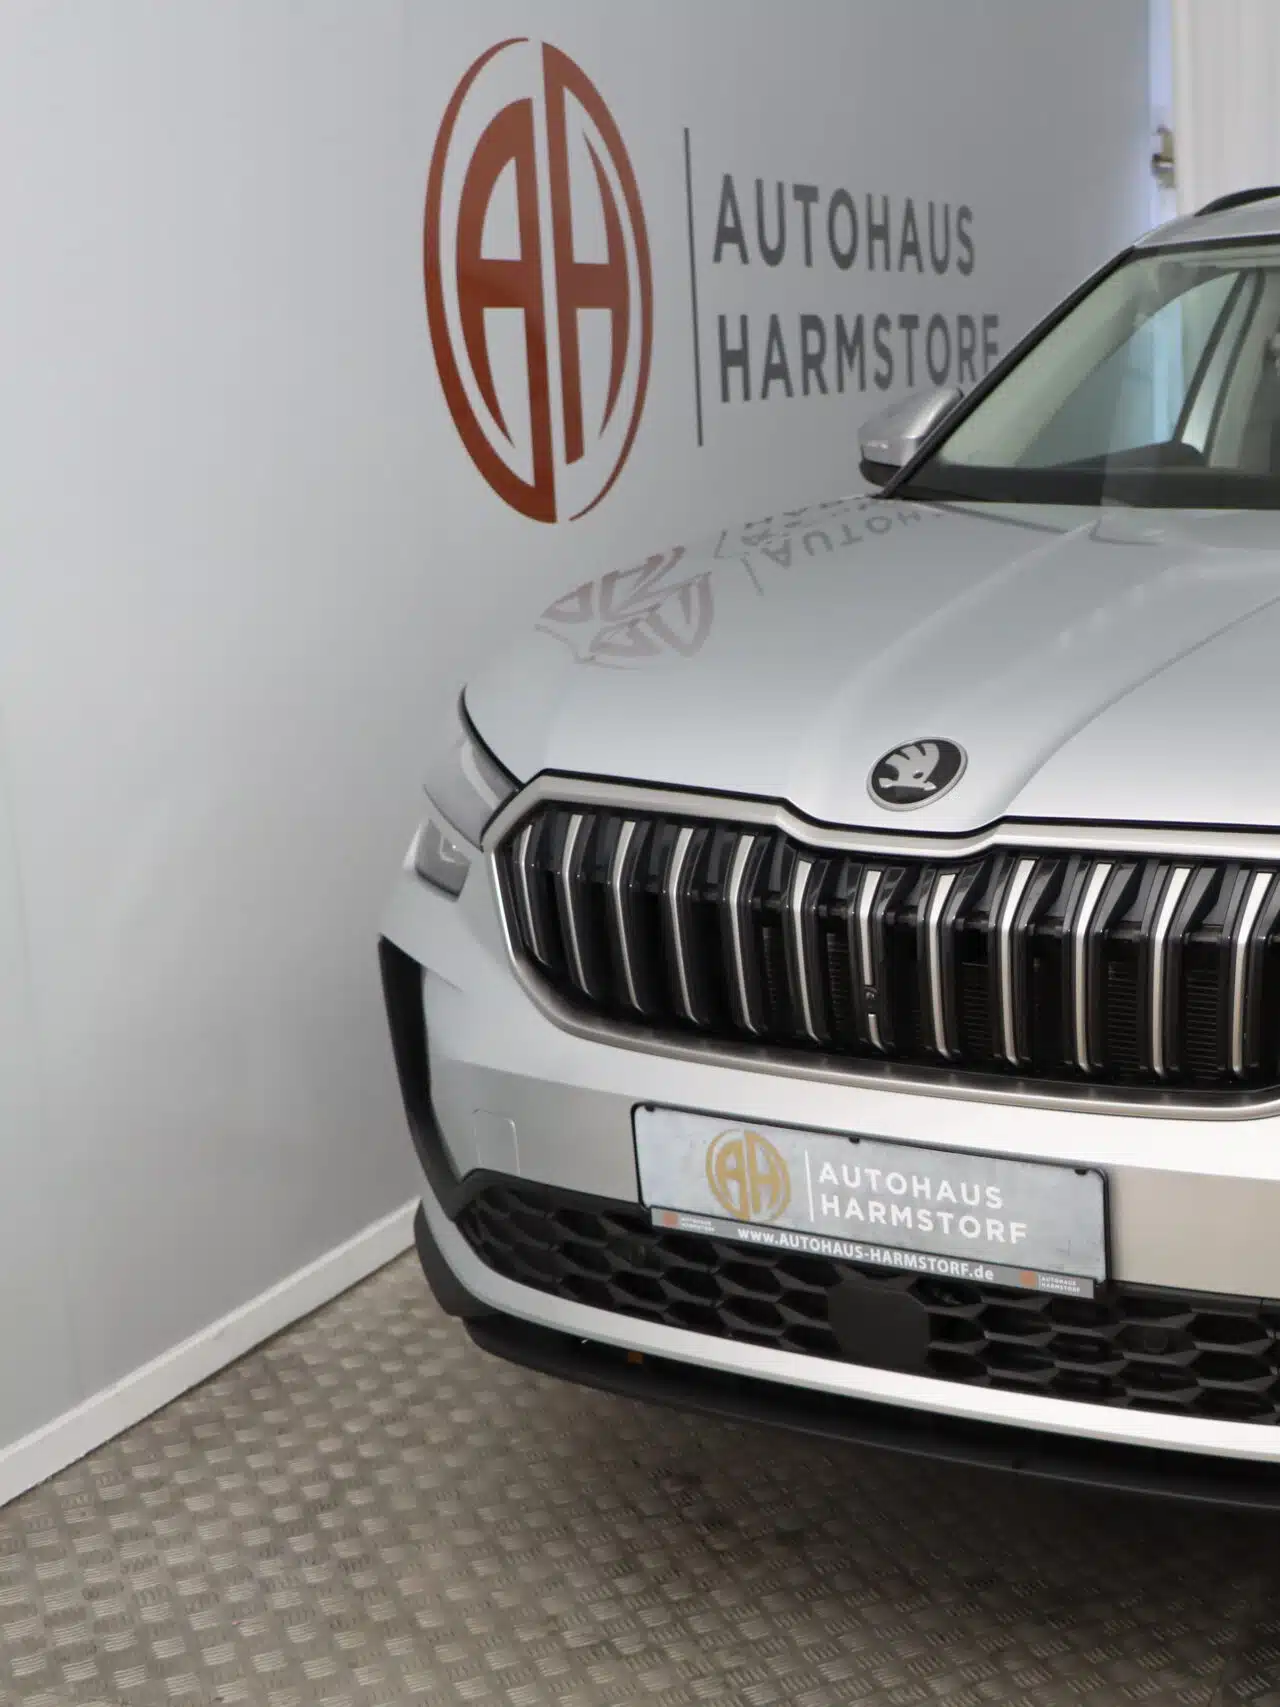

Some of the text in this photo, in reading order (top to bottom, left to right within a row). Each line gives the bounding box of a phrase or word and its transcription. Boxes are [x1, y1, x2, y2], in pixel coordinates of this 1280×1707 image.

[712, 173, 975, 277] AUTOHAUS
[717, 313, 1001, 403] HARMSTORF
[818, 1161, 1003, 1210] AUTOHAUS
[821, 1193, 1028, 1244] HARMSTORF
[737, 1227, 995, 1282] www.AUTOHAUS-HARMSTORF.de
